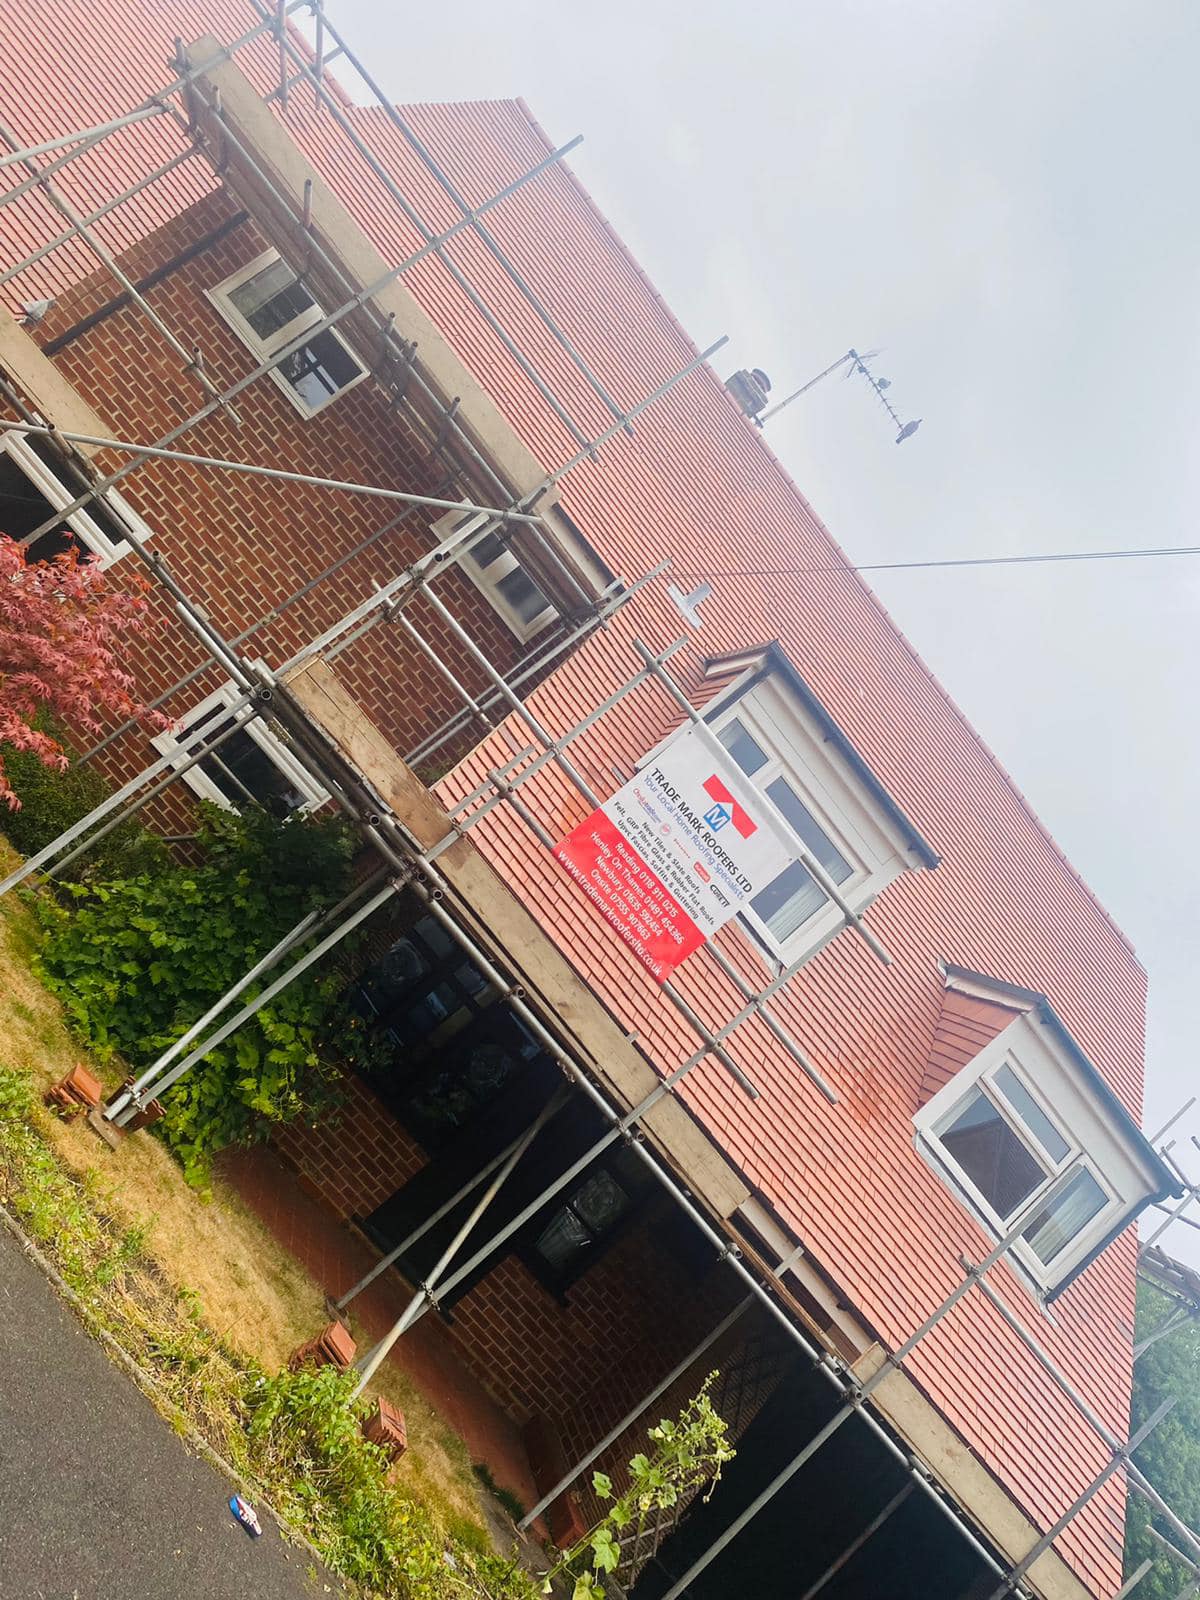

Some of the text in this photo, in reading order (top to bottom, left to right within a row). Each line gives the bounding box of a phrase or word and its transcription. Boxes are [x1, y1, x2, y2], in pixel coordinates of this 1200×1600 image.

[641, 821, 654, 837] New
[653, 836, 666, 852] Tiles
[671, 858, 685, 875] Slate
[684, 874, 700, 894] Roofs
[643, 774, 658, 792] Your
[656, 791, 676, 813] Local
[672, 811, 692, 835] Home
[690, 833, 715, 865] Roofing
[713, 862, 744, 900] Specialists
[651, 767, 680, 803] TRADE
[677, 801, 704, 834] MARK
[701, 831, 738, 875] ROOFERS
[735, 873, 752, 892] LTD
[706, 806, 728, 829] M
[590, 831, 684, 944] Henley On Thames 01491 454366
[590, 869, 650, 940] Onsite 07555 907663
[595, 855, 662, 936] Newbury 01635 592454
[613, 801, 625, 817] Felt,
[626, 816, 639, 829] GRP
[637, 830, 651, 847] Fibre
[650, 847, 665, 864] Glass
[670, 870, 689, 893] Rubber
[688, 892, 700, 906] Flat
[699, 905, 714, 925] Roofs
[615, 842, 678, 917] Reading 0118 911 0215
[630, 835, 648, 860] Fascias,
[649, 859, 668, 882] Soffits
[673, 887, 698, 919] Guttering
[558, 850, 662, 976] www.trademarkroofersltd.co.uk
